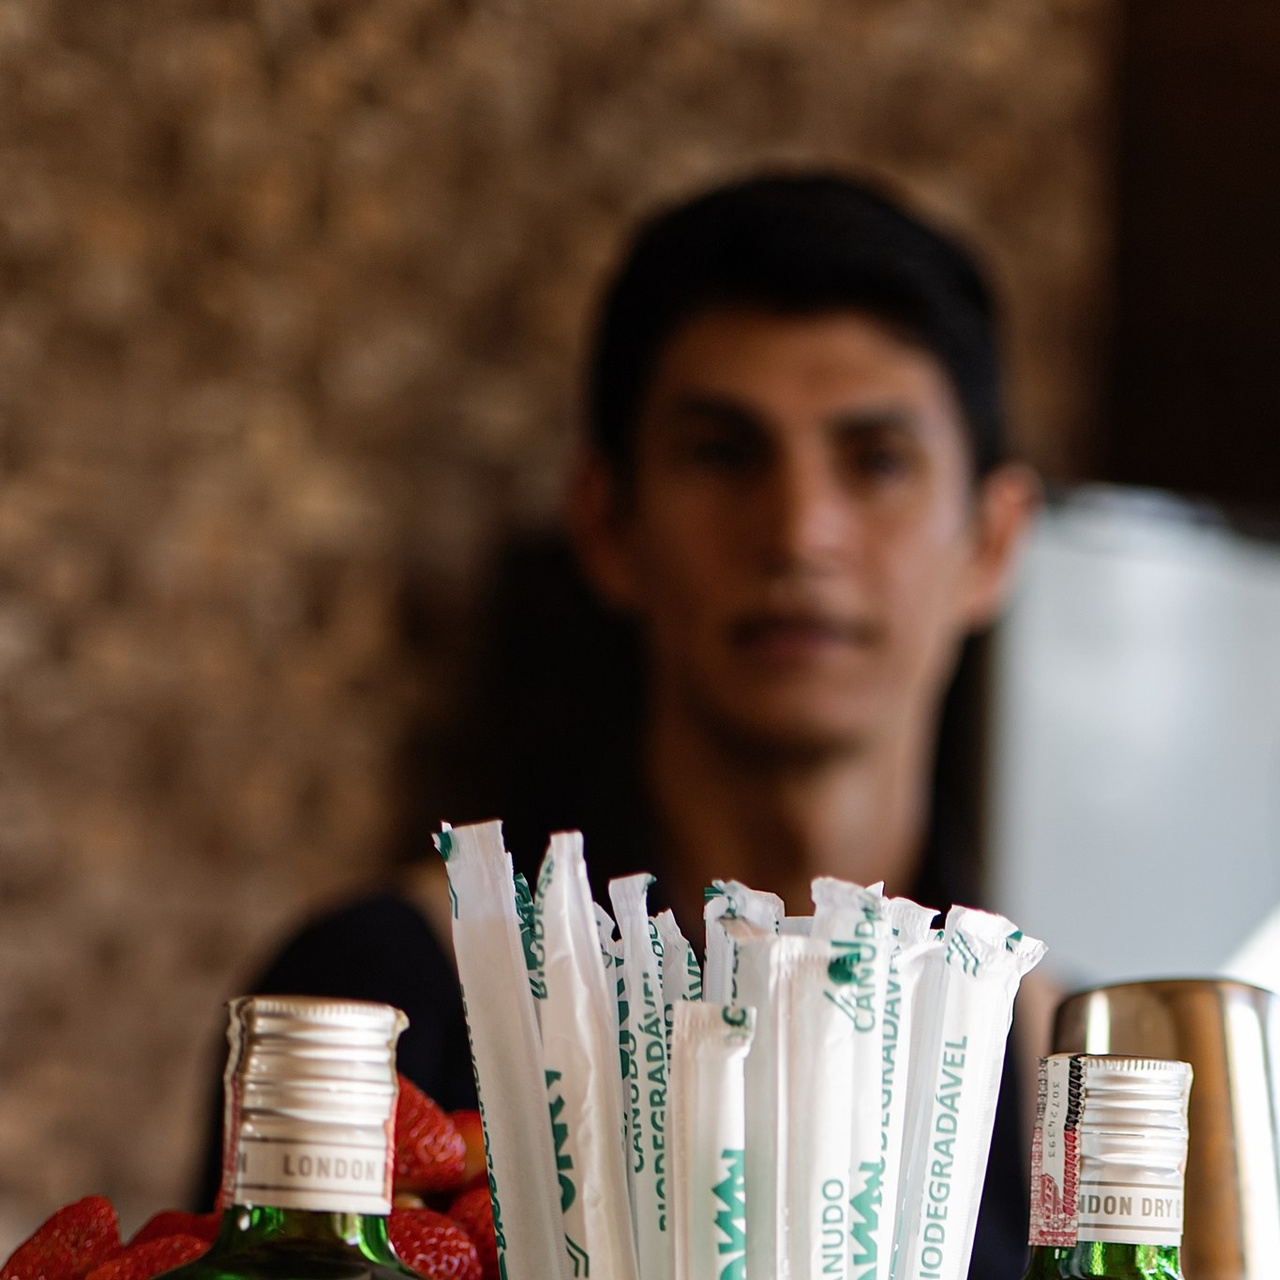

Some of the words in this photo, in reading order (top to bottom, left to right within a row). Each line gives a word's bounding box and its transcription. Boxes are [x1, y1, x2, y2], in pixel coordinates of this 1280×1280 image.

[282, 1154, 377, 1182] LONDON
[1080, 1195, 1133, 1217] NDON
[1141, 1198, 1173, 1219] DRY
